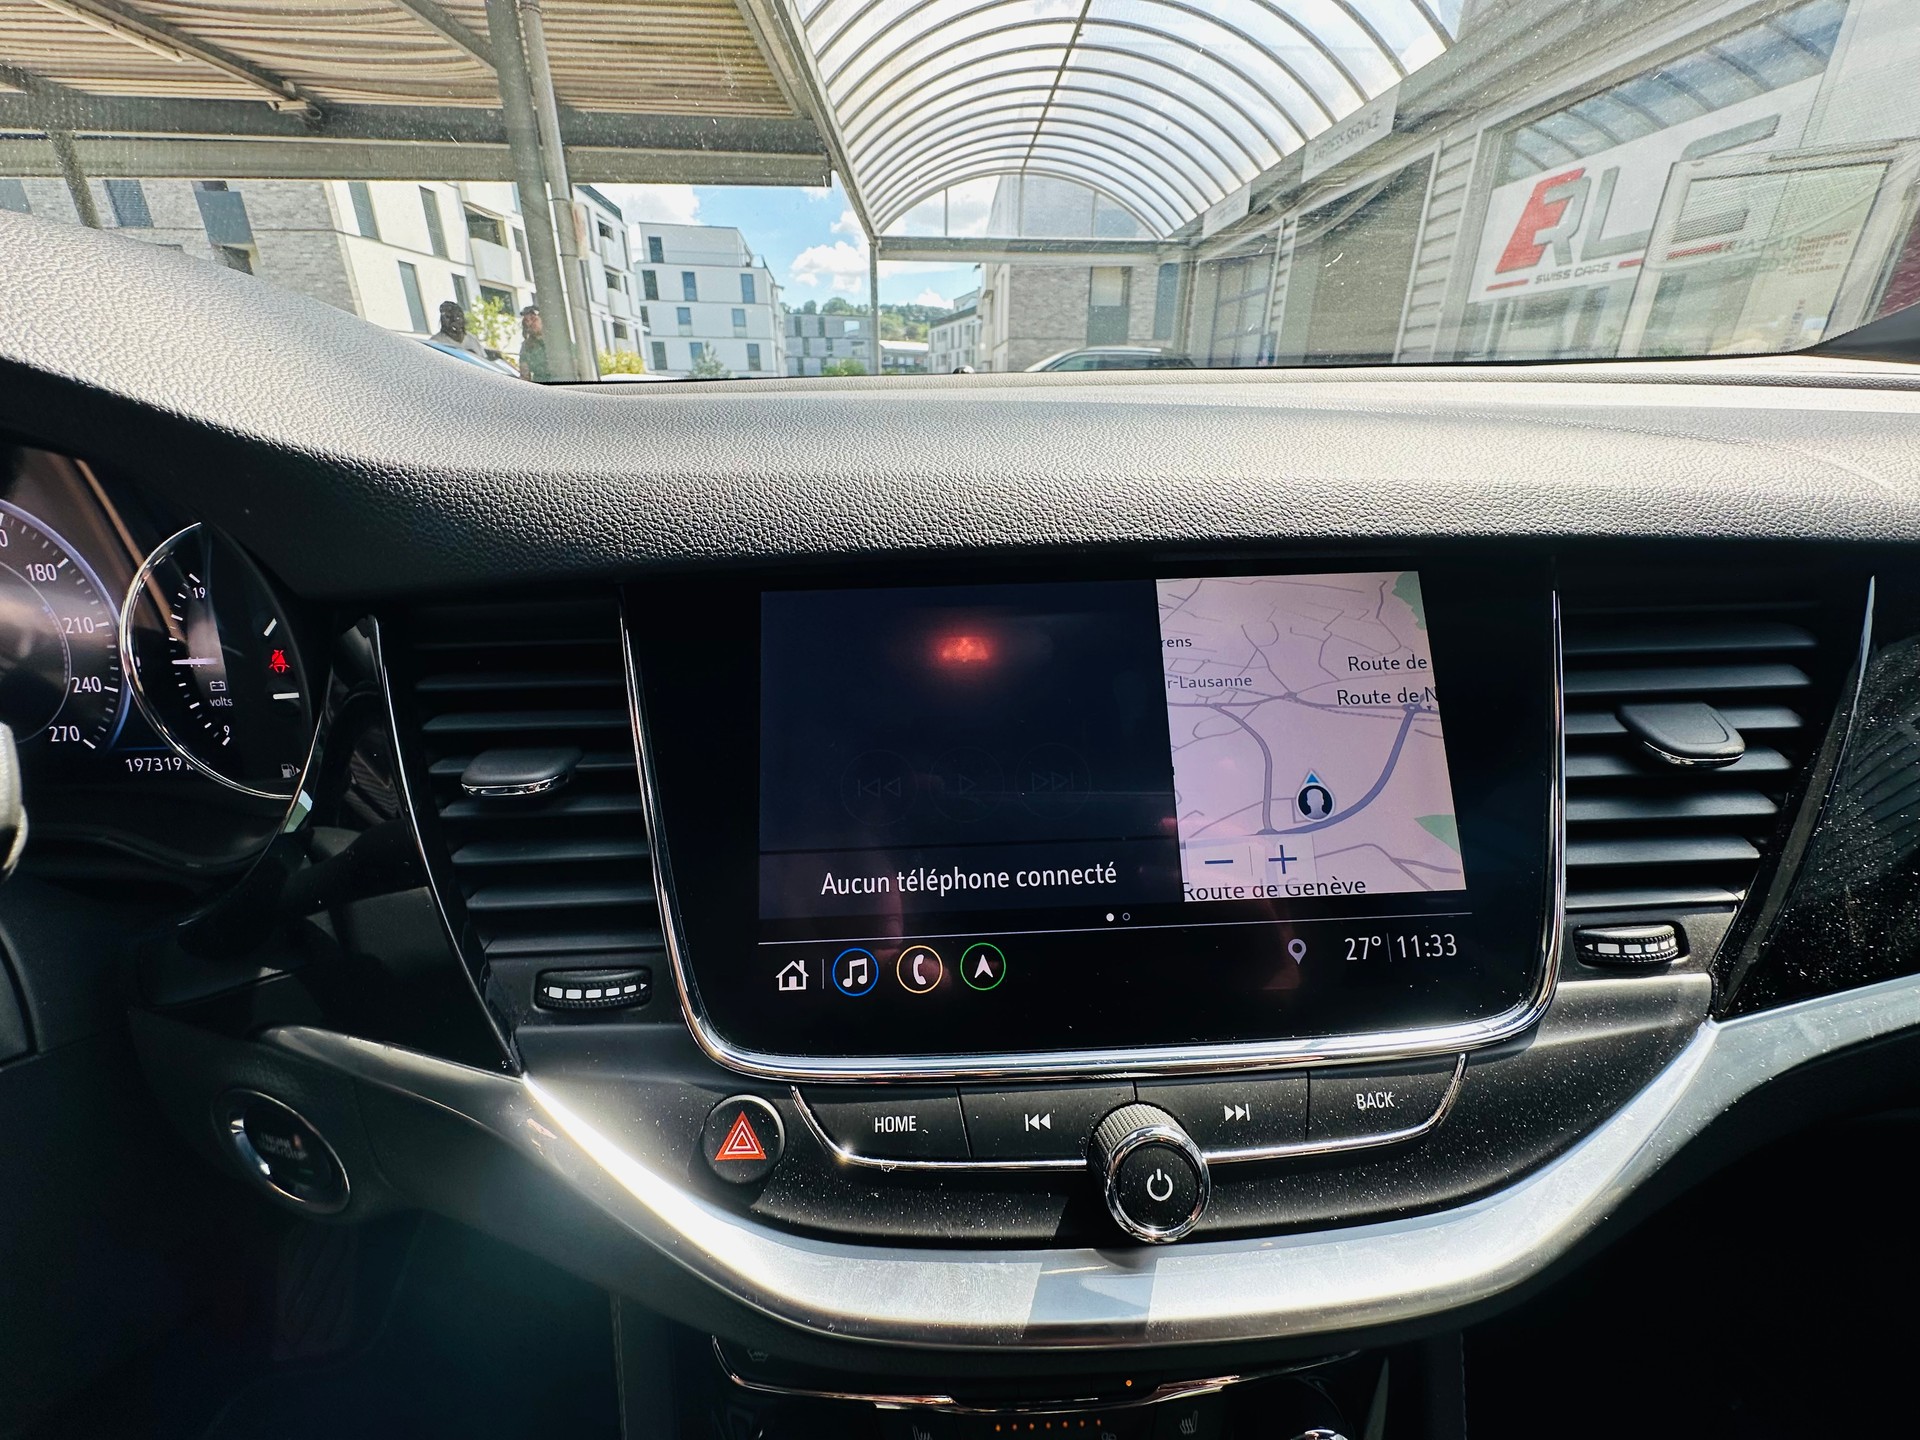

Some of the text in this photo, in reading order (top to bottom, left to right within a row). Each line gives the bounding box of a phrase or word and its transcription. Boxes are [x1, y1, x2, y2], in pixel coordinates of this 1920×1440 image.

[1535, 262, 1611, 284] SWISS CARS
[25, 563, 57, 582] 180
[192, 587, 206, 599] 19
[63, 617, 95, 634] 210
[1348, 653, 1427, 671] Route de
[71, 676, 102, 693] 240
[1167, 676, 1252, 689] r-Lausanne
[209, 697, 233, 707] volts
[1337, 689, 1391, 705] Route
[1397, 686, 1419, 703] de
[49, 726, 80, 742] 270
[223, 725, 230, 736] 9
[125, 757, 182, 773] 197319
[821, 861, 1117, 897] Aucun téléphone connecté
[1182, 876, 1366, 900] Route de Genève
[1344, 933, 1457, 961] 27° 11:33
[1356, 1091, 1395, 1110] BACK
[874, 1115, 917, 1133] HOME
